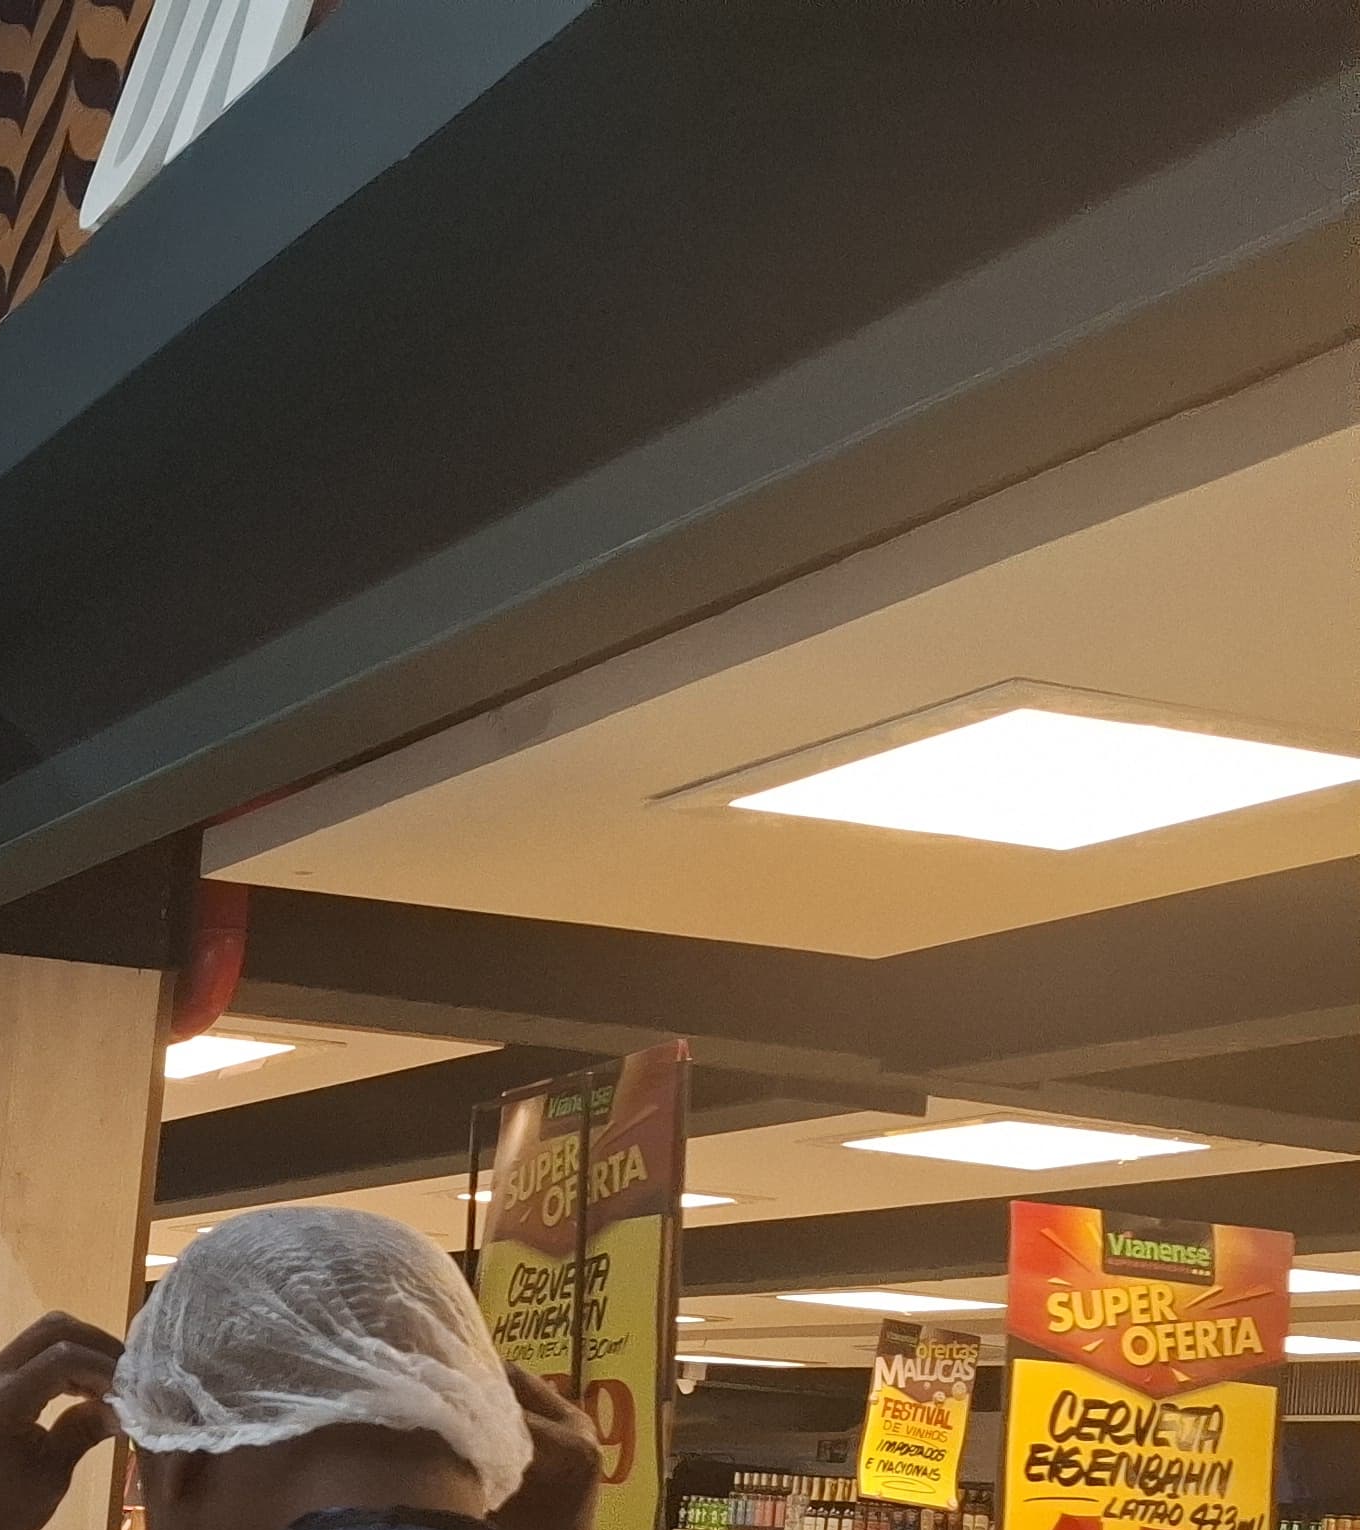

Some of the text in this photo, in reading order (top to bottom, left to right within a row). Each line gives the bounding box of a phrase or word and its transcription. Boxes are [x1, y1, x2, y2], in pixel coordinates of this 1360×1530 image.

[503, 1134, 580, 1211] SUPER
[541, 1143, 649, 1228] OFRTA
[1106, 1231, 1211, 1267] Vianense
[1046, 1283, 1179, 1333] SUPER
[915, 1339, 978, 1361] ofertas
[1120, 1316, 1265, 1367] OFERTA
[873, 1354, 976, 1392] MALUCAS
[880, 1397, 953, 1431] FESTIVAL
[882, 1419, 949, 1443] DE VINHOS
[865, 1457, 941, 1483] E NACIONAIS
[1024, 1443, 1234, 1500] EISENBAHN
